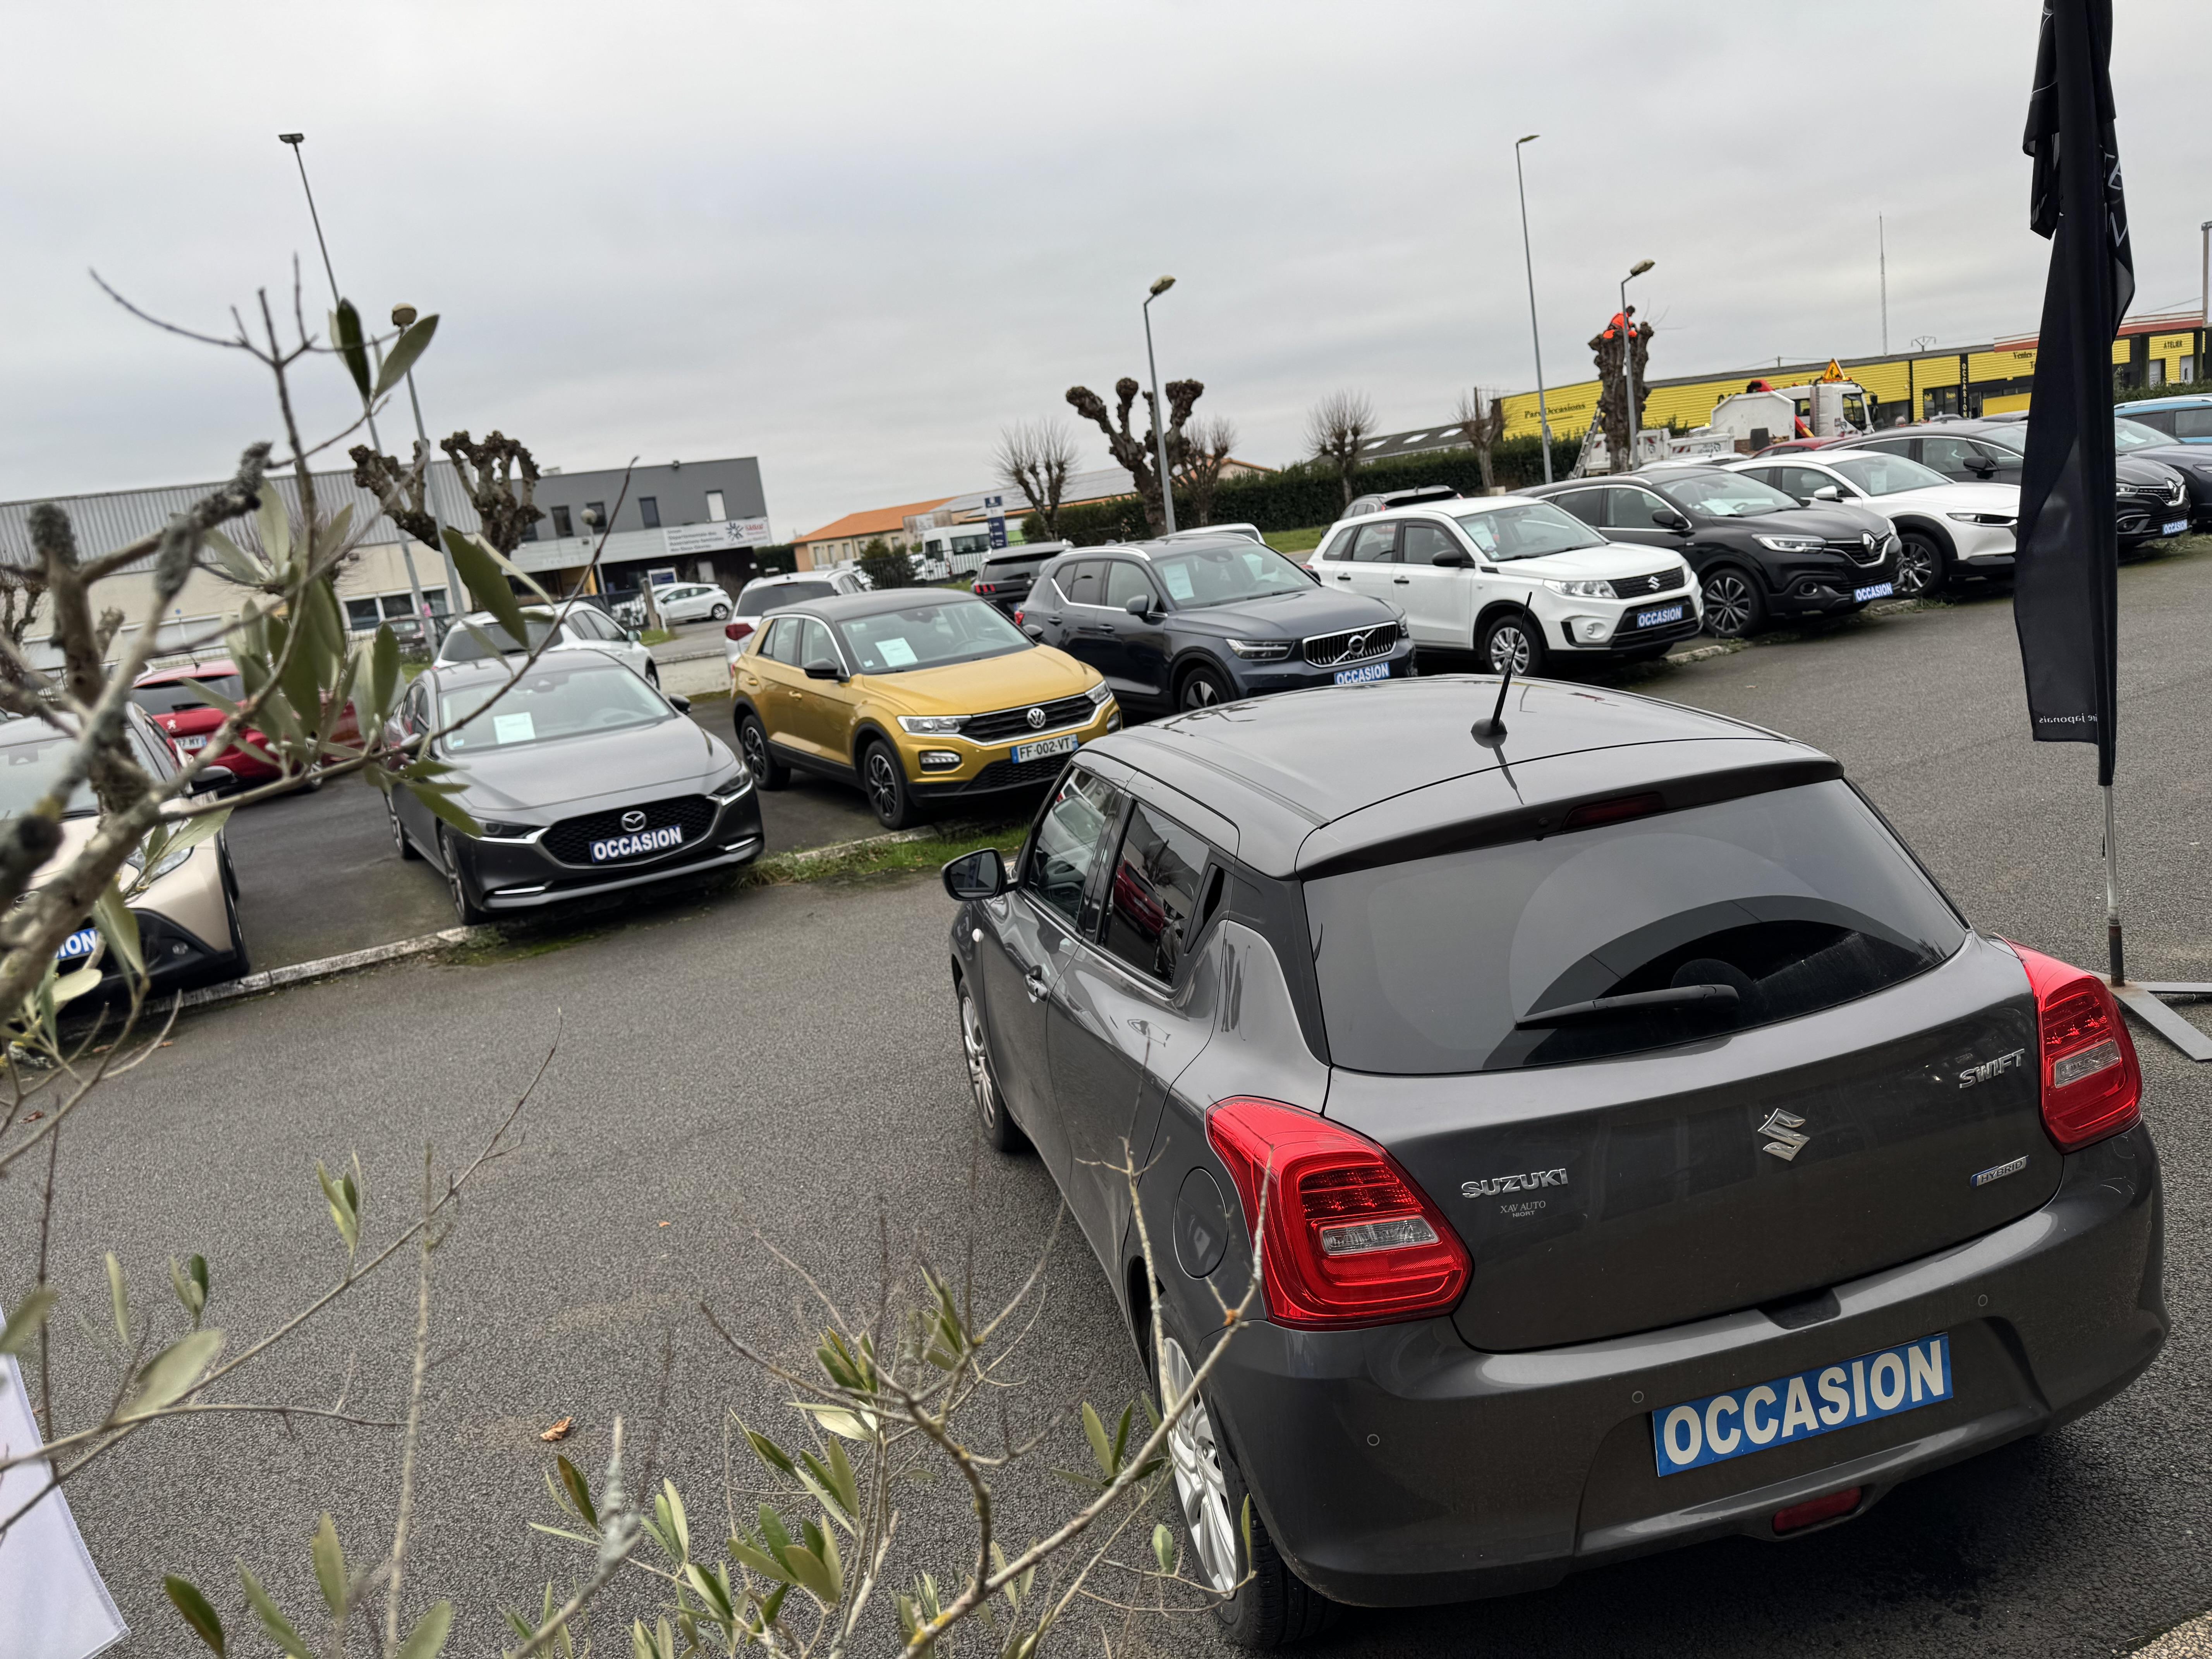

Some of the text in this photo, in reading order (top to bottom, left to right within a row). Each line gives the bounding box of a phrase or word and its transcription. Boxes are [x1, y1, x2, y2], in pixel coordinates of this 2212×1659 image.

[2164, 340, 2183, 349] ATELIER
[1856, 582, 1893, 601] OCCASION
[1638, 606, 1682, 627] OCCASION
[1336, 662, 1389, 685] OCCASION
[1019, 737, 1070, 759] FF-002-VT
[594, 826, 682, 860] OCCASION
[1960, 1048, 2025, 1089] SWIFT
[1981, 1161, 2023, 1183] HYBRID
[1461, 1168, 1568, 1199] SUZUKI
[1500, 1200, 1546, 1214] XAV AUTO
[1664, 1340, 1944, 1465] OCCASION
